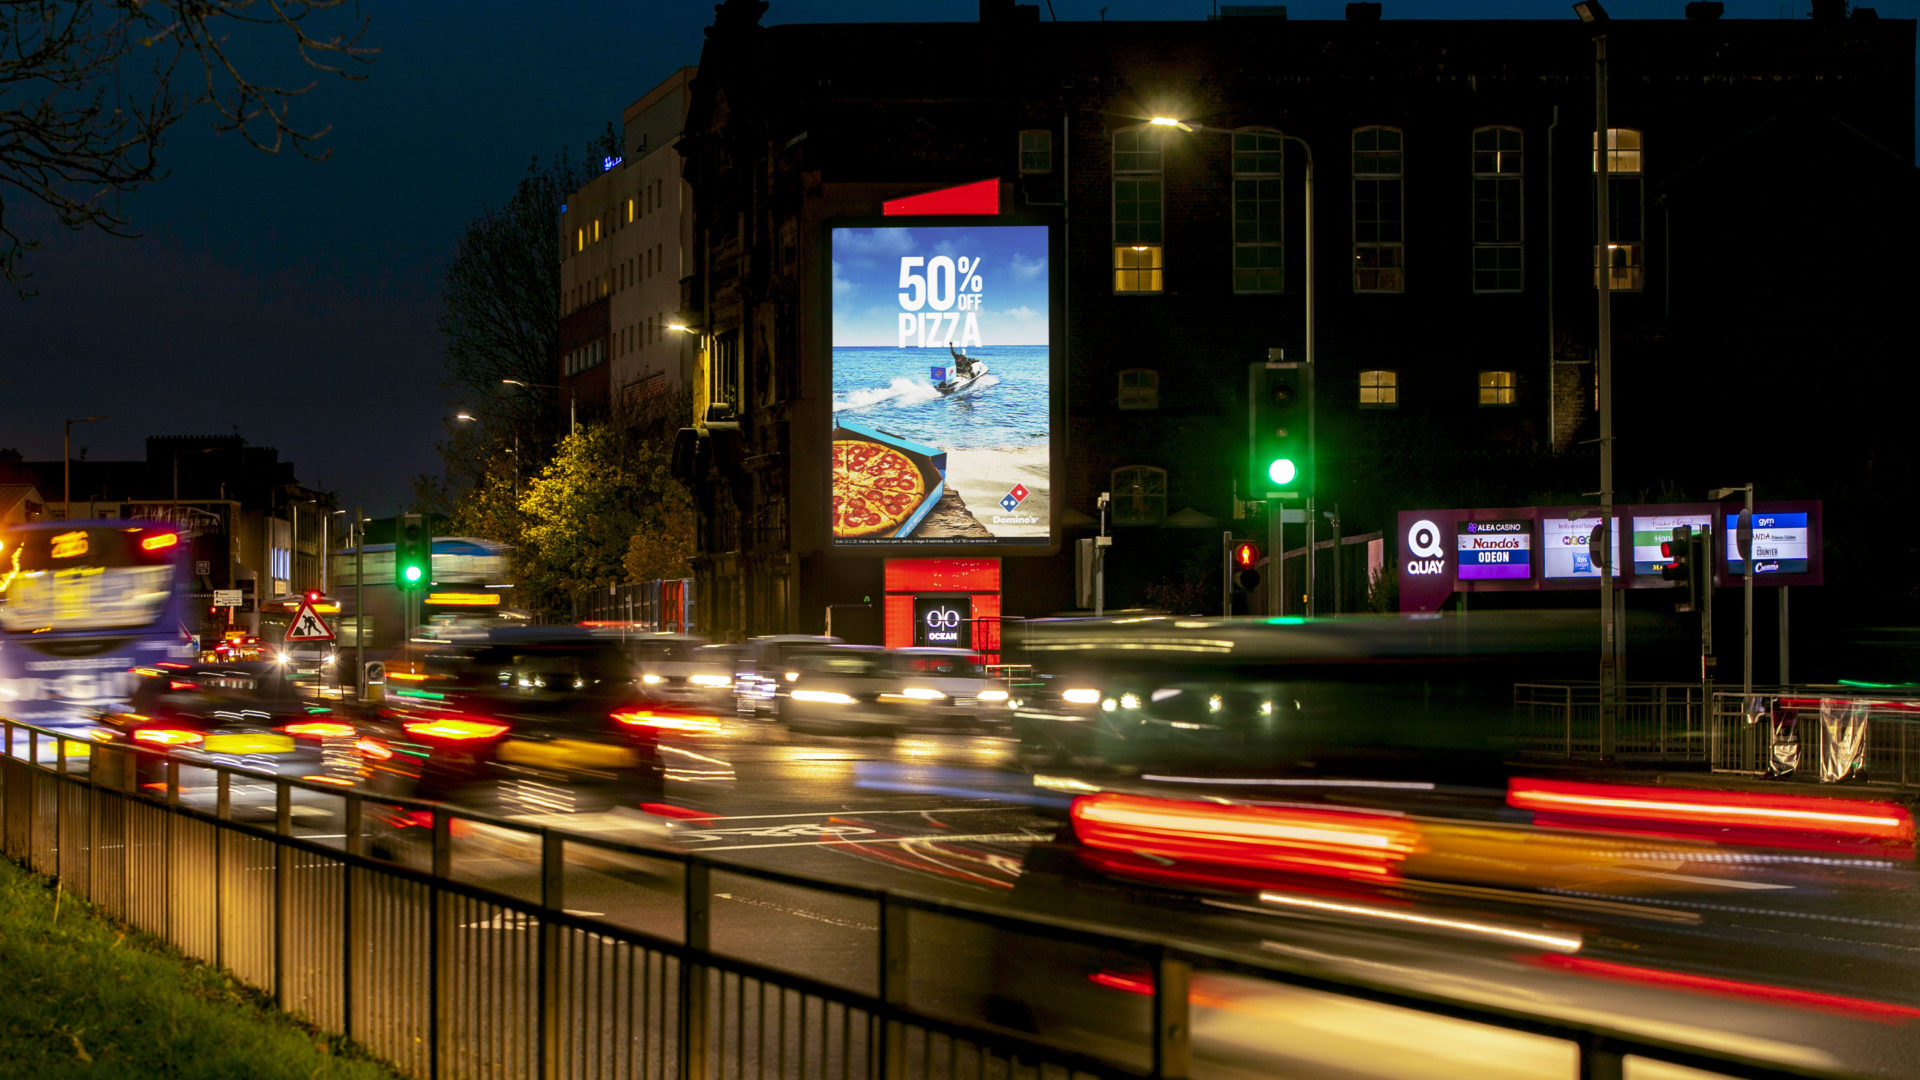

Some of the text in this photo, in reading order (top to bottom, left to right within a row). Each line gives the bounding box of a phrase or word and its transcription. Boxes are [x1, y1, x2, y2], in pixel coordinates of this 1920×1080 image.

[898, 255, 983, 311] 50%
[958, 293, 983, 311] OFF
[898, 311, 983, 348] PIZZA
[993, 515, 1037, 524] Domino's
[1477, 523, 1521, 532] ALEA CASINO
[1472, 538, 1520, 549] Nando's
[1478, 551, 1510, 563] ODEON
[1407, 560, 1445, 575] QUAY
[928, 632, 958, 640] OCEAN
